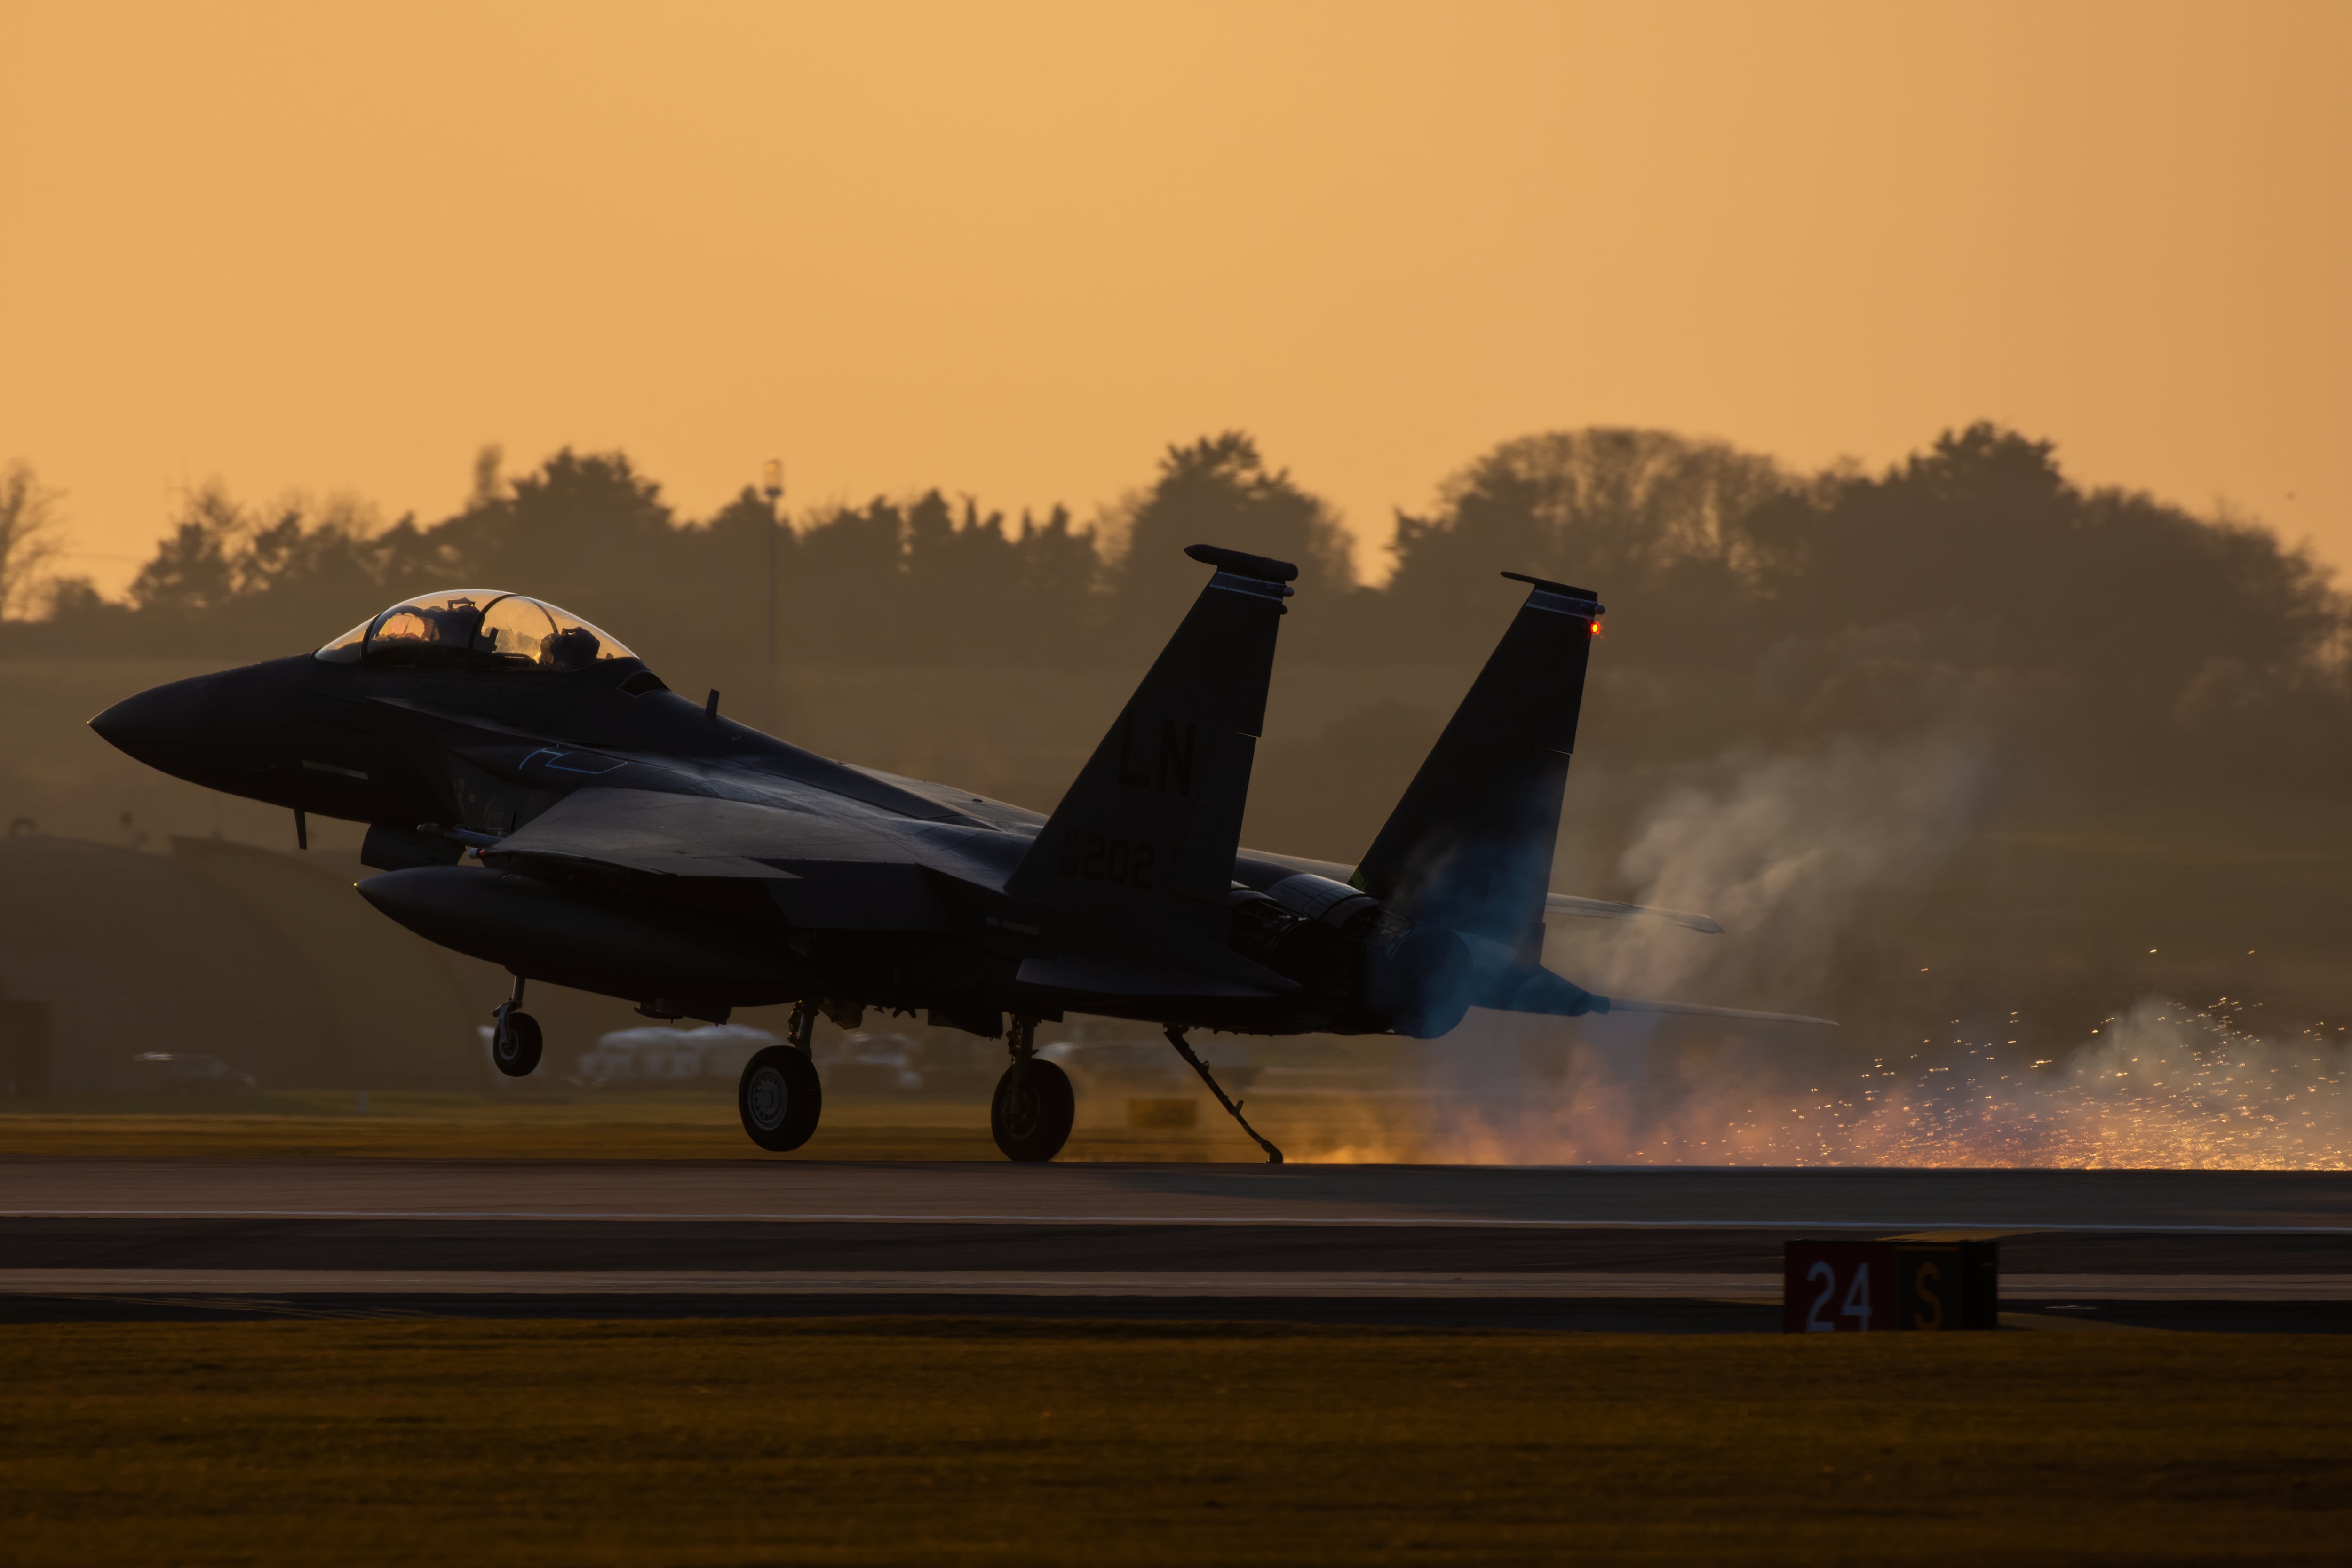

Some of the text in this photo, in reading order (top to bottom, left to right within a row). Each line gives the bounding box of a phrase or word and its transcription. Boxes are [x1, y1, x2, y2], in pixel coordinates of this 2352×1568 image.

[1118, 713, 1196, 797] LN
[1082, 832, 1155, 891] 202
[1805, 1260, 1944, 1332] 24 S
